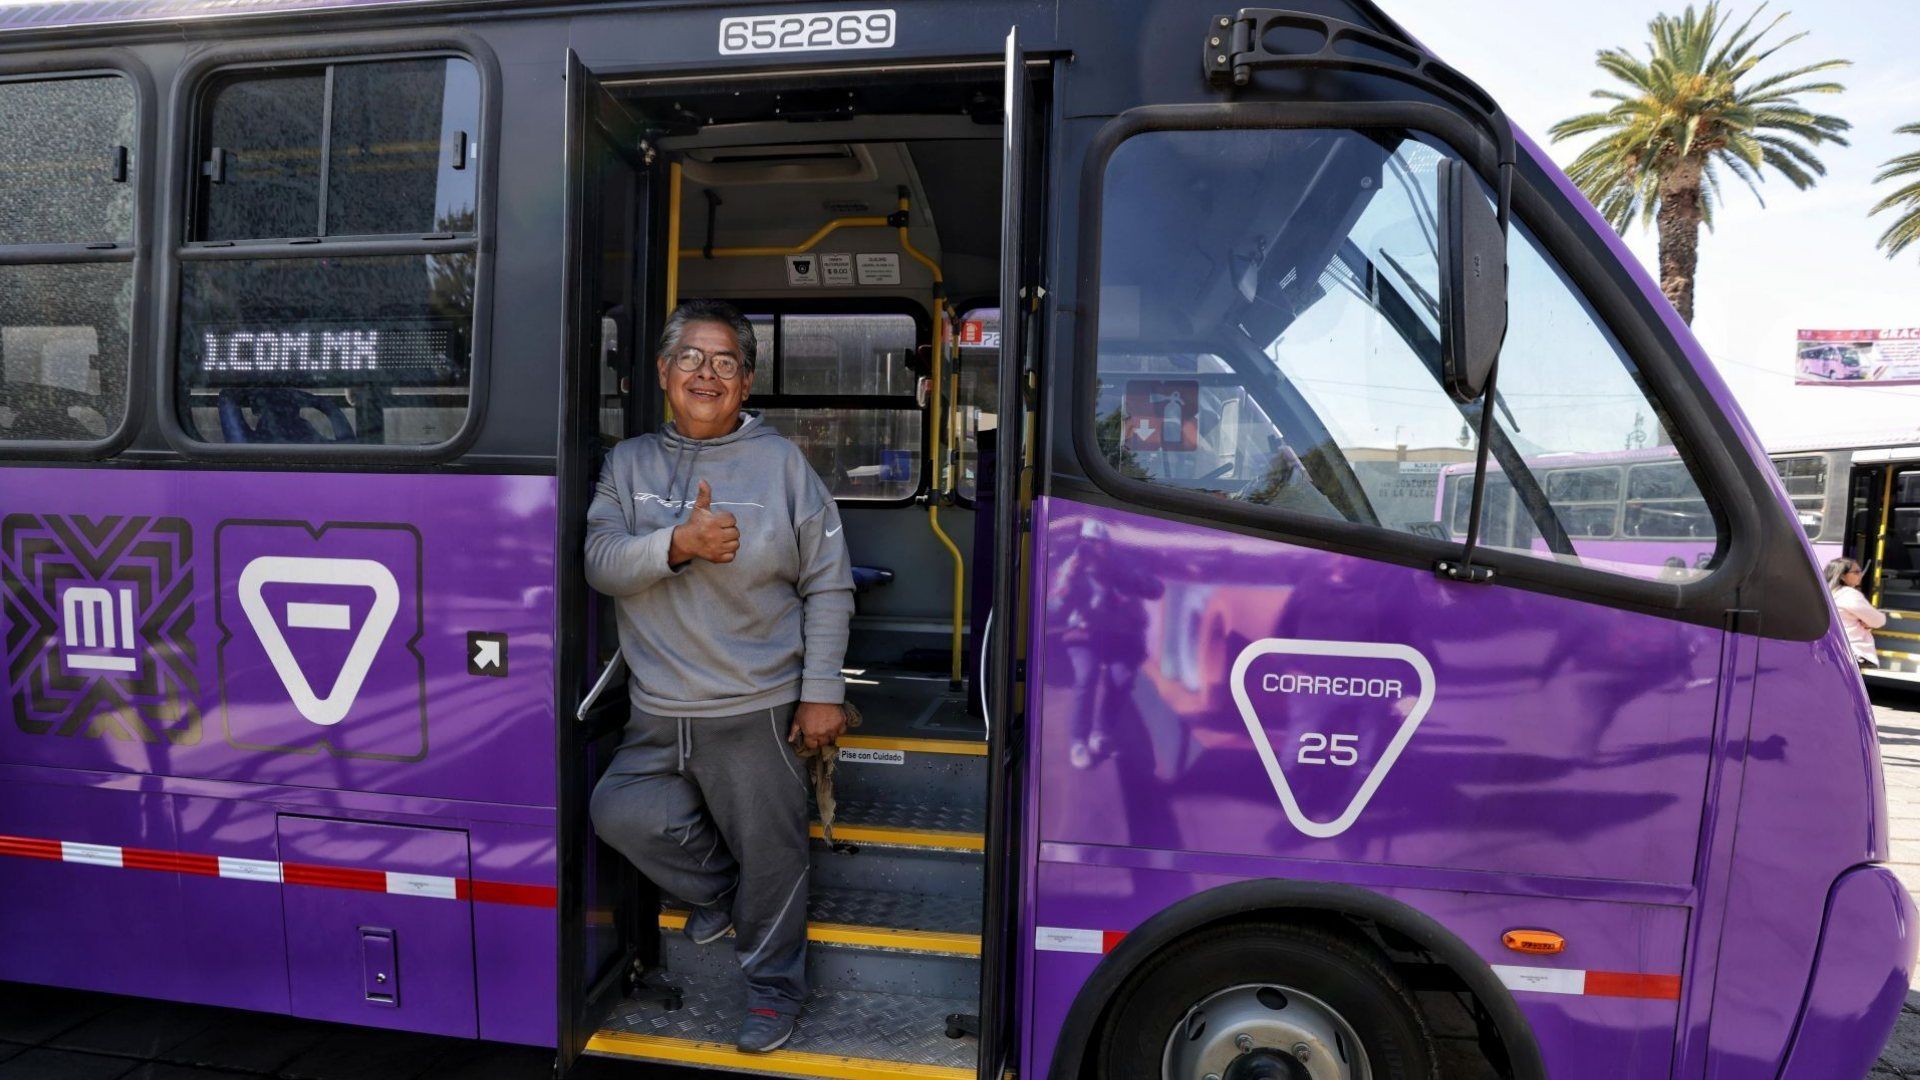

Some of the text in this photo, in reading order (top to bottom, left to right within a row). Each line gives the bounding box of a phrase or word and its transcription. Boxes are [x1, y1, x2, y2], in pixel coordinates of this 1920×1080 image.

[724, 14, 891, 51] 652269
[1262, 673, 1402, 699] CORREDOR
[841, 750, 857, 759] Pise
[872, 751, 902, 761] Cuidado
[1297, 732, 1359, 766] 25
